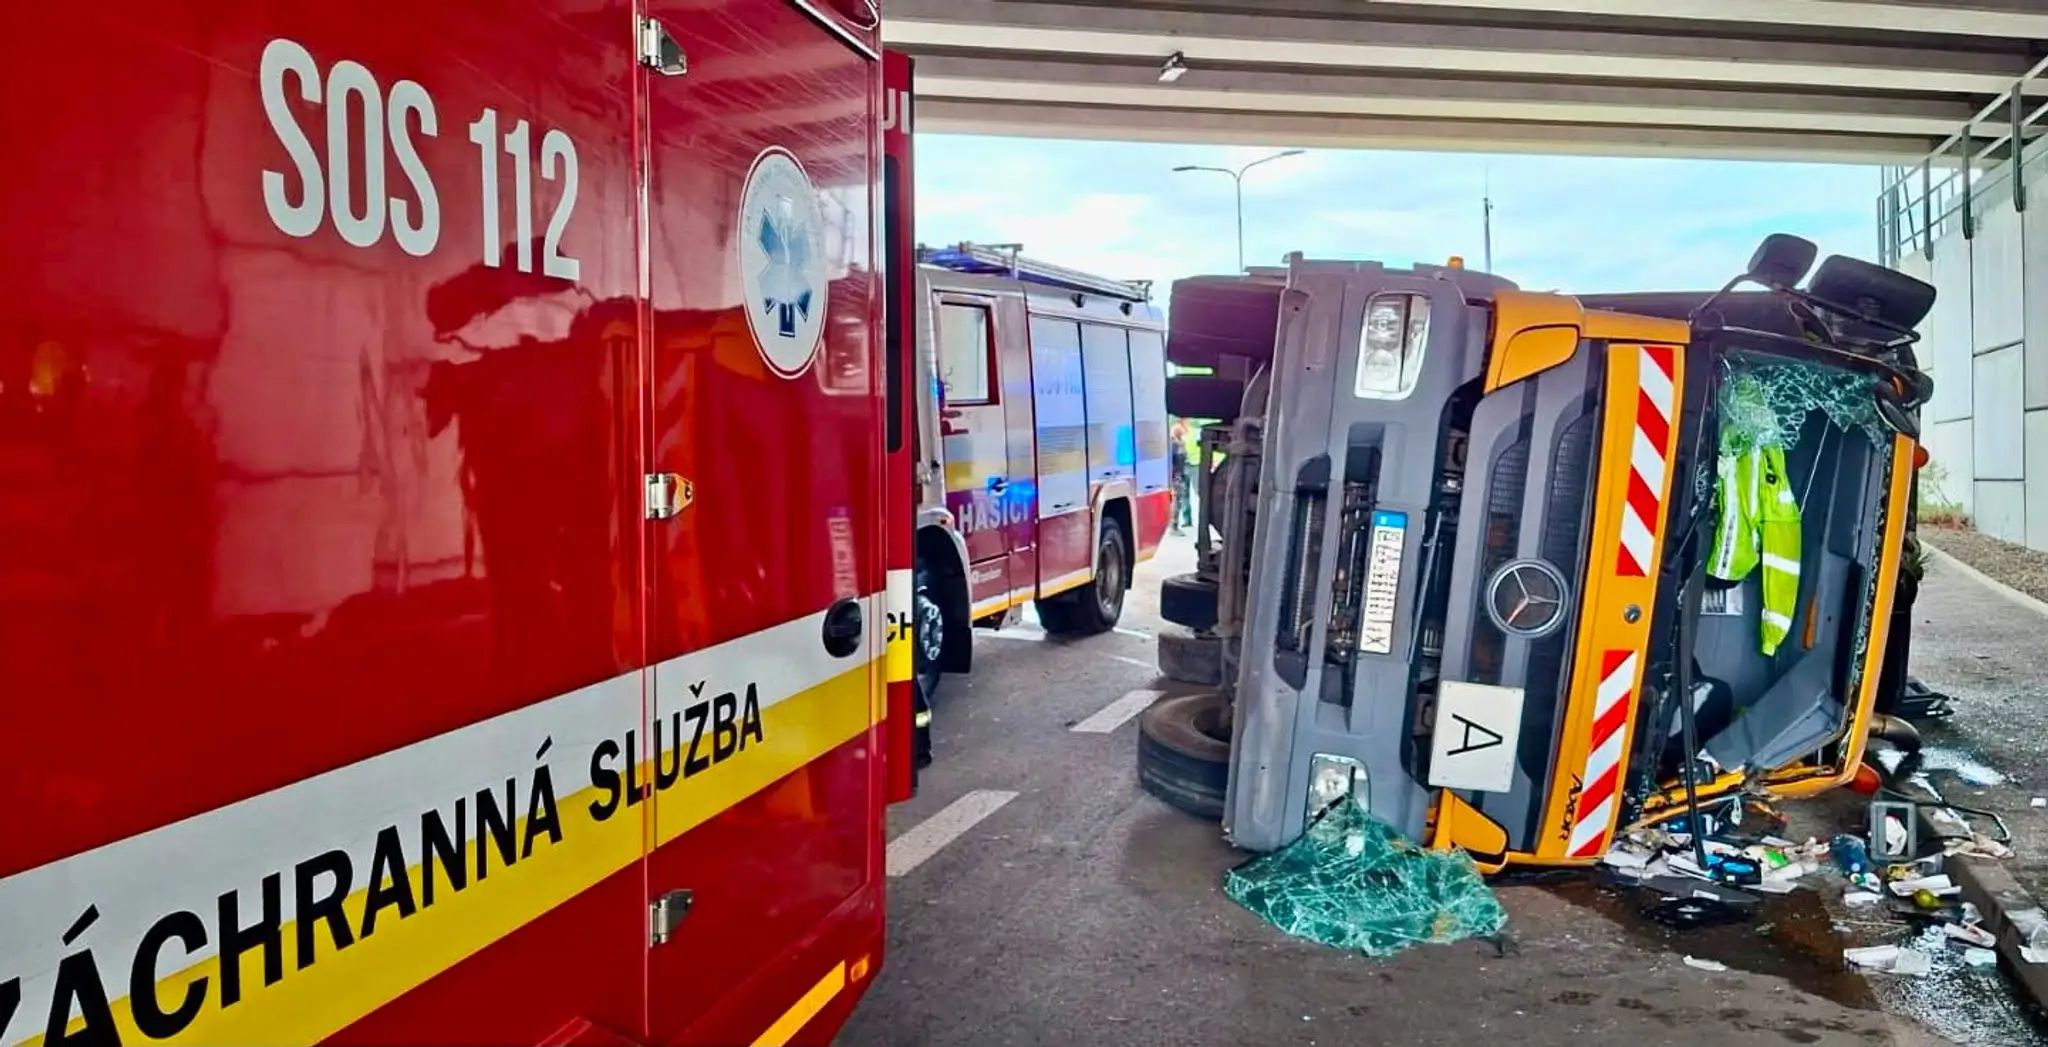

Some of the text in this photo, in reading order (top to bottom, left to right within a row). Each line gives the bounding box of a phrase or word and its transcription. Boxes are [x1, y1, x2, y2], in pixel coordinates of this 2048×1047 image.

[260, 38, 441, 257] SOS
[469, 107, 581, 281] 112
[588, 680, 763, 821] SLUŽBA
[1447, 713, 1504, 756] A
[1558, 772, 1584, 841] AXOR
